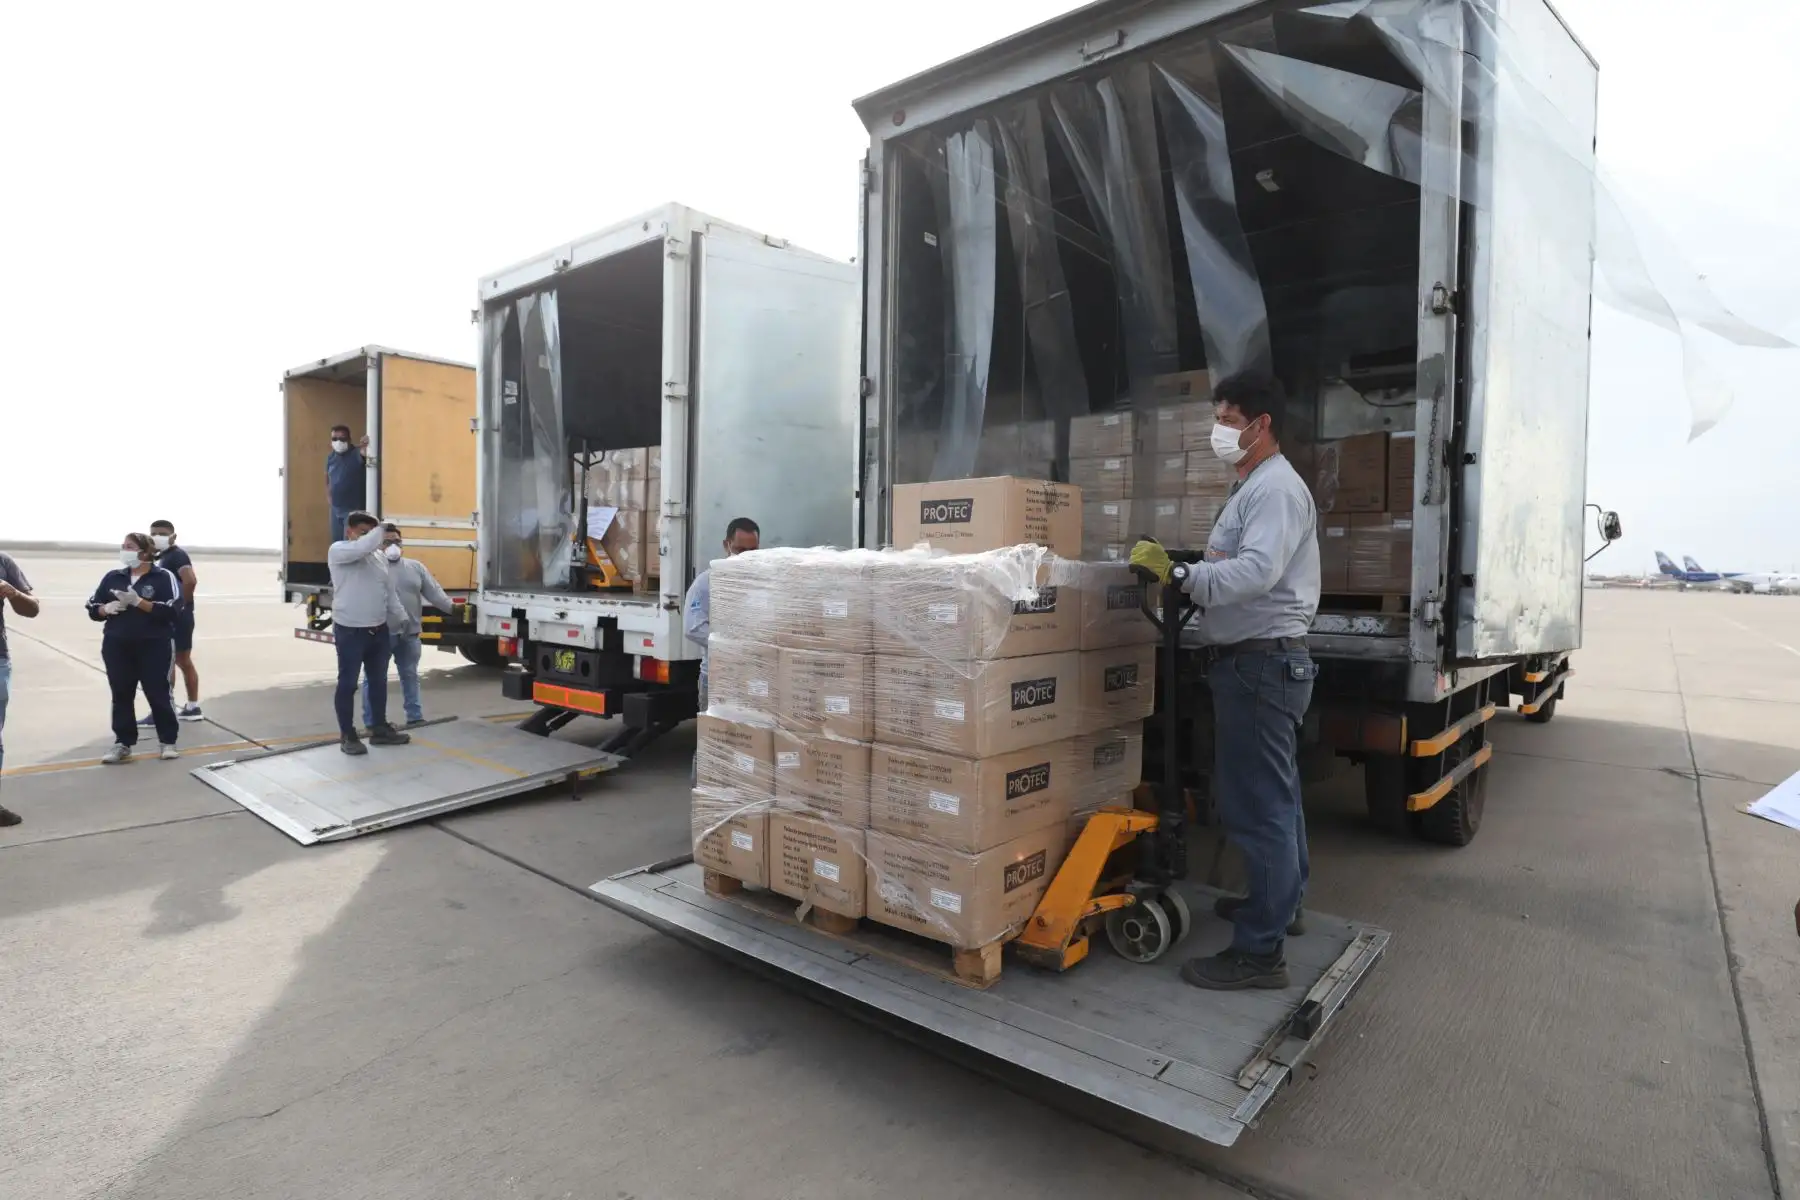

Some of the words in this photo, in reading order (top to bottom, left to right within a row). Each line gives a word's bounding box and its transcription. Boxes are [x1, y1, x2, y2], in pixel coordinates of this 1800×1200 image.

[923, 504, 968, 522] PROTEC
[1014, 685, 1052, 705] PROTEC
[1008, 771, 1047, 794] PROTEC
[1006, 860, 1042, 889] PROTEC
